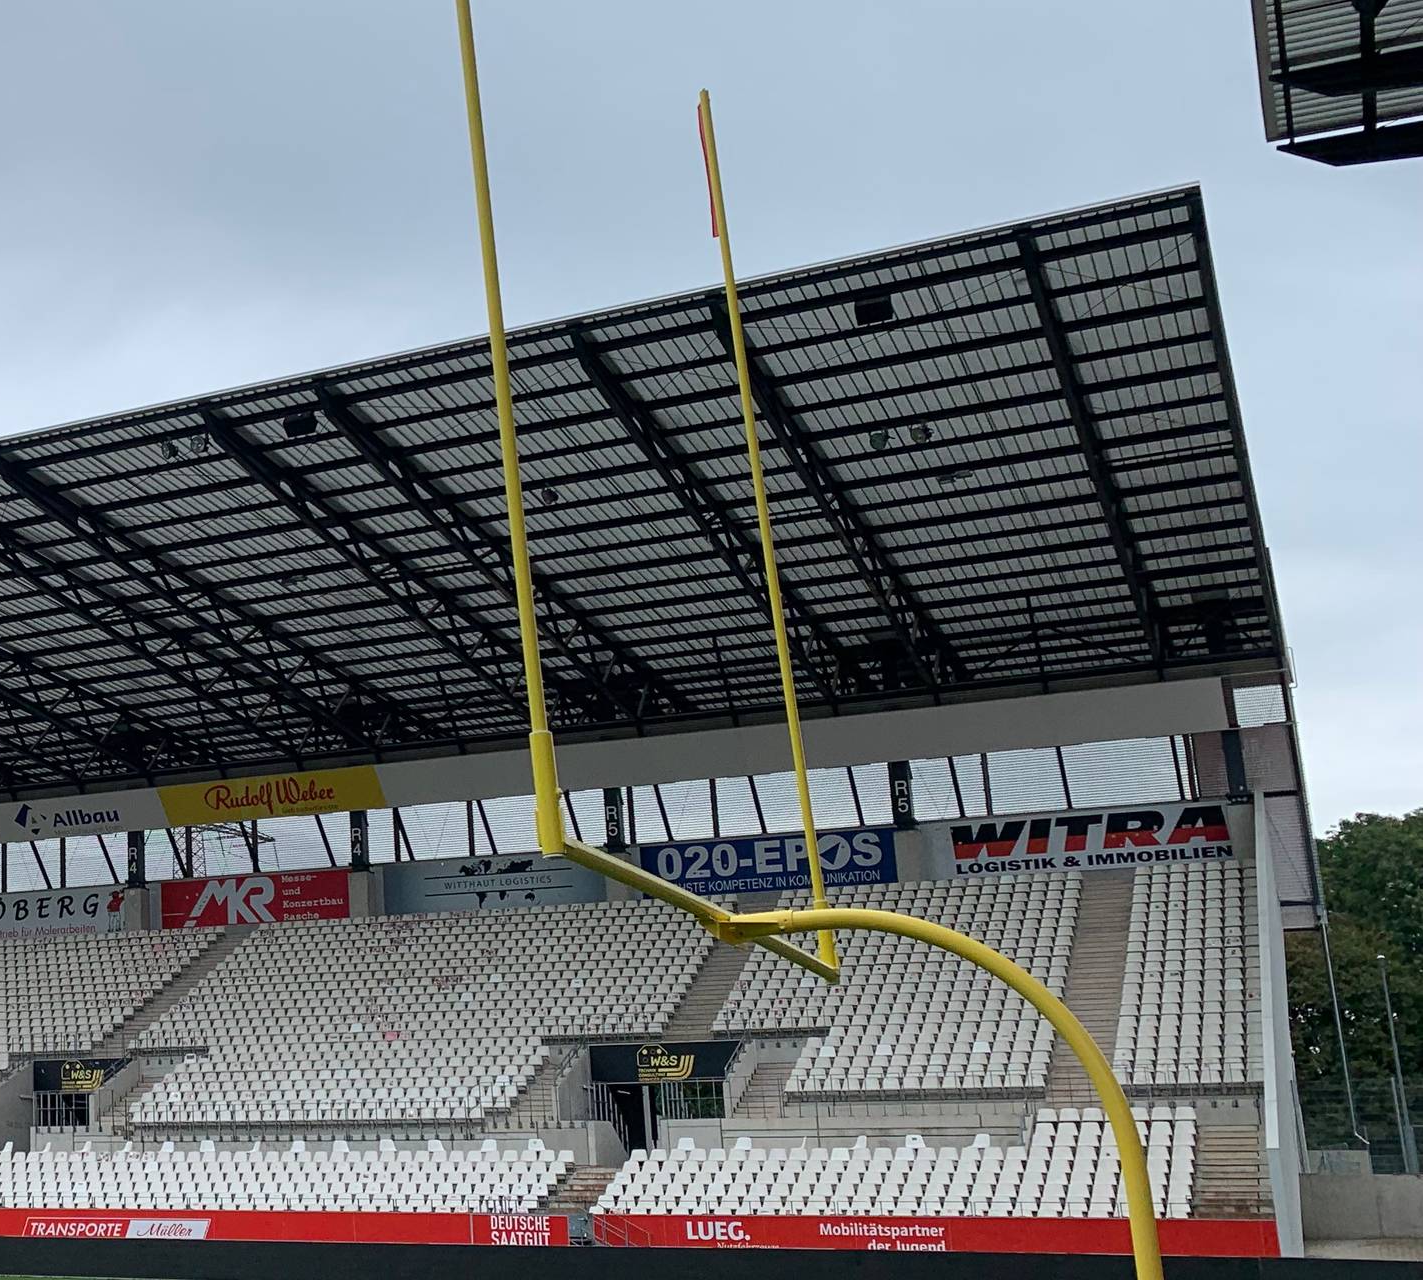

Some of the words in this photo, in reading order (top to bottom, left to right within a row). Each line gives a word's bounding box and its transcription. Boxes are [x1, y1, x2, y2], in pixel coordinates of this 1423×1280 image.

[204, 781, 274, 815] Rudolf
[276, 777, 335, 804] Weber
[53, 809, 120, 827] Allbau
[950, 805, 1231, 860] WITRA
[955, 856, 1057, 875] LOGISTIK
[1065, 856, 1078, 868] &
[1088, 845, 1233, 866] IMMOBILIEN
[281, 874, 317, 883] Messe-
[444, 878, 496, 890] WITTHAUT
[500, 875, 552, 886] LOGISTICS
[708, 877, 773, 892] KOMPETENZ
[776, 876, 788, 887] IN
[788, 870, 881, 888] KOMUNIKATION
[282, 887, 301, 896] und
[183, 877, 276, 927] MKR
[282, 897, 344, 908] Konzertbau
[283, 912, 319, 921] Rasche
[21, 926, 32, 937] für
[35, 924, 96, 937] Malerarbeiten
[650, 1055, 678, 1067] W&S
[71, 1070, 92, 1080] W&S
[30, 1222, 123, 1236] TRANSPORTE
[137, 1223, 193, 1237] Müller
[490, 1215, 550, 1231] DEUTSCHE
[685, 1221, 751, 1241] LUEG.
[819, 1222, 945, 1239] Mobilitätspartner
[491, 1232, 550, 1245] SAATGUT
[868, 1239, 893, 1251] der
